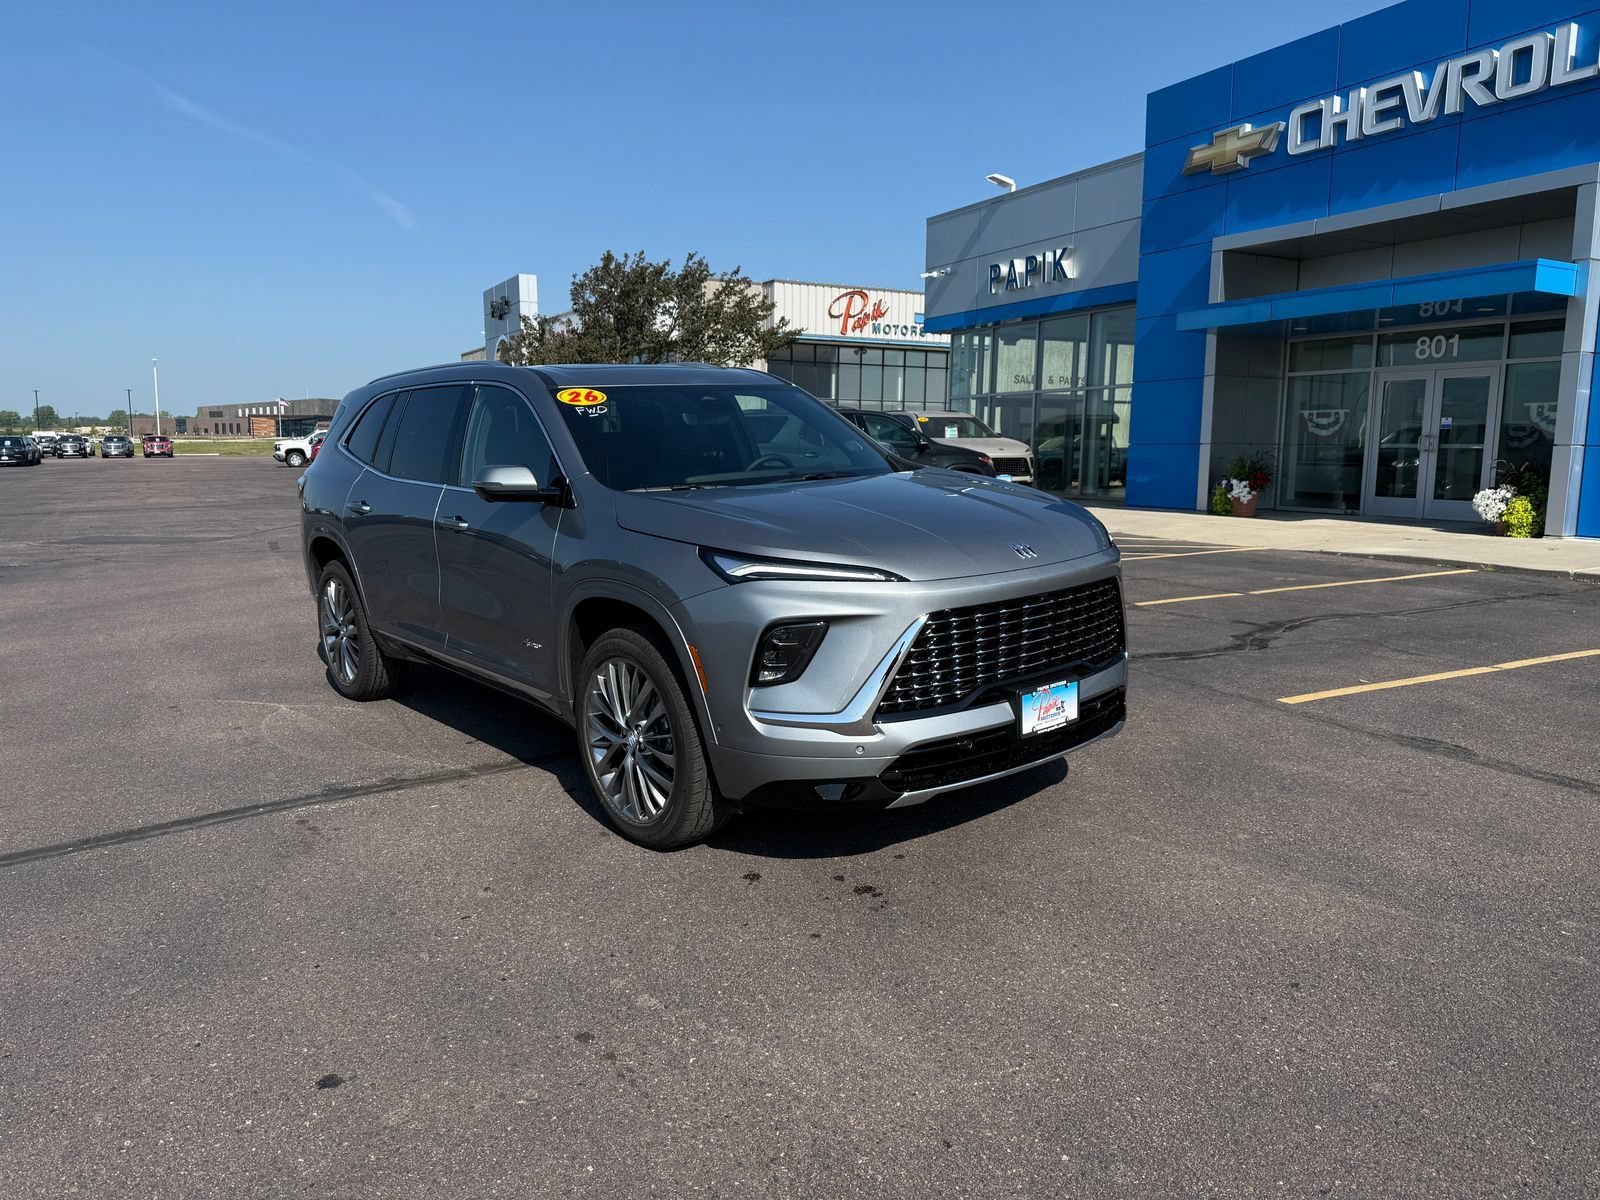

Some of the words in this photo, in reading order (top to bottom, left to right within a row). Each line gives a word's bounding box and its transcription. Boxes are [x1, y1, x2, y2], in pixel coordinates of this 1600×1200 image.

[1287, 22, 1600, 155] CHEVROL
[988, 246, 1073, 294] PAPIK
[828, 290, 889, 335] Papik
[872, 322, 925, 337] MOTORS
[1415, 333, 1460, 359] 801
[1014, 373, 1036, 385] SAL
[1048, 375, 1054, 384] &
[1059, 376, 1086, 385] PATS
[567, 390, 598, 403] 26
[575, 405, 608, 416] FWD
